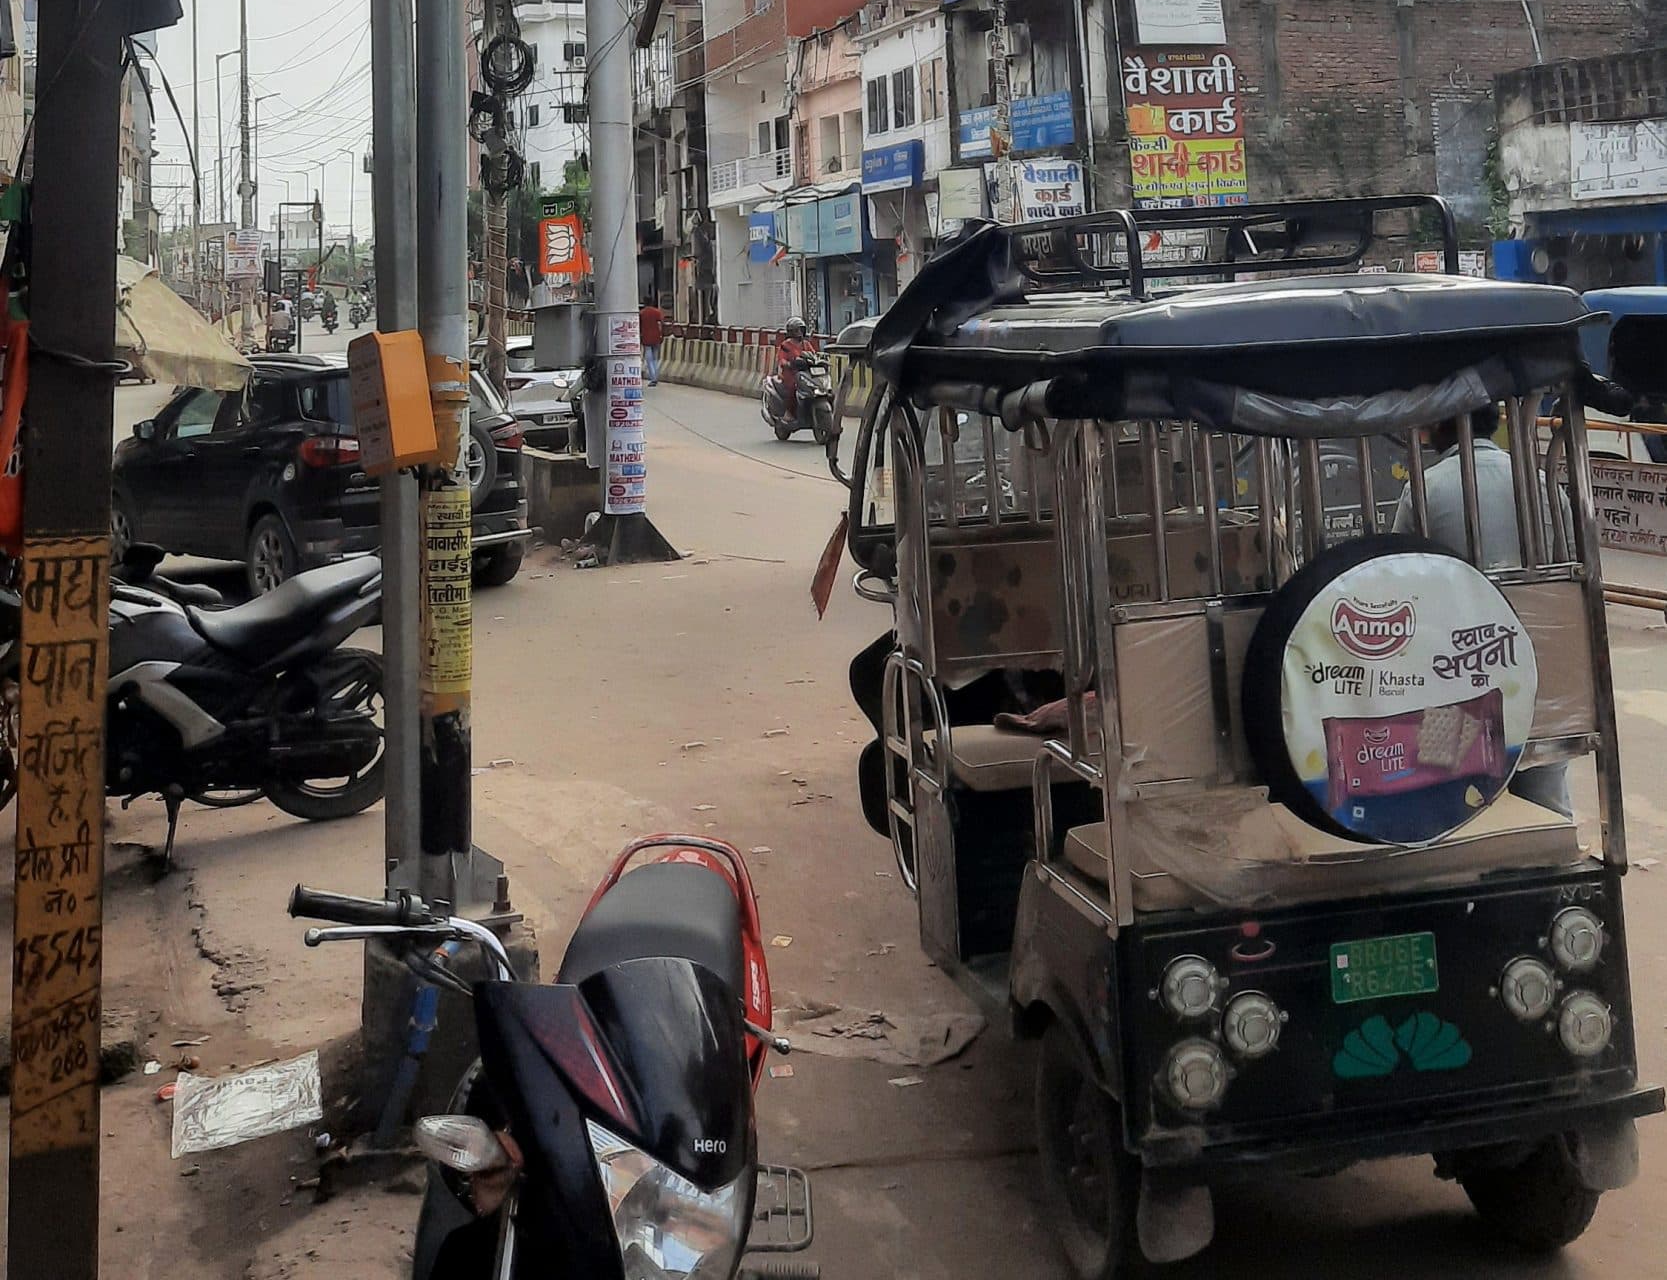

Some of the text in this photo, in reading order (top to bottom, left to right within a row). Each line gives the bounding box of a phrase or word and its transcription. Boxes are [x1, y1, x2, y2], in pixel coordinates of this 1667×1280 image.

[1123, 53, 1237, 96] वैशाली
[1166, 96, 1237, 134] कार्ड
[1195, 139, 1245, 176] कार्ड
[1023, 163, 1080, 183] वैशाली
[1034, 183, 1073, 203] कार्ड
[1026, 203, 1056, 219] शादी
[1627, 488, 1654, 504] समय
[1334, 614, 1414, 638] Anmol
[1432, 626, 1518, 680] सपनों
[26, 639, 98, 708] पान
[1311, 662, 1365, 685] dream
[1379, 670, 1425, 687] Khasta
[1470, 674, 1490, 688] का
[1335, 680, 1363, 696] LITE
[1357, 742, 1405, 764] dream
[1381, 756, 1406, 772] LITE
[694, 1138, 727, 1153] Hero
